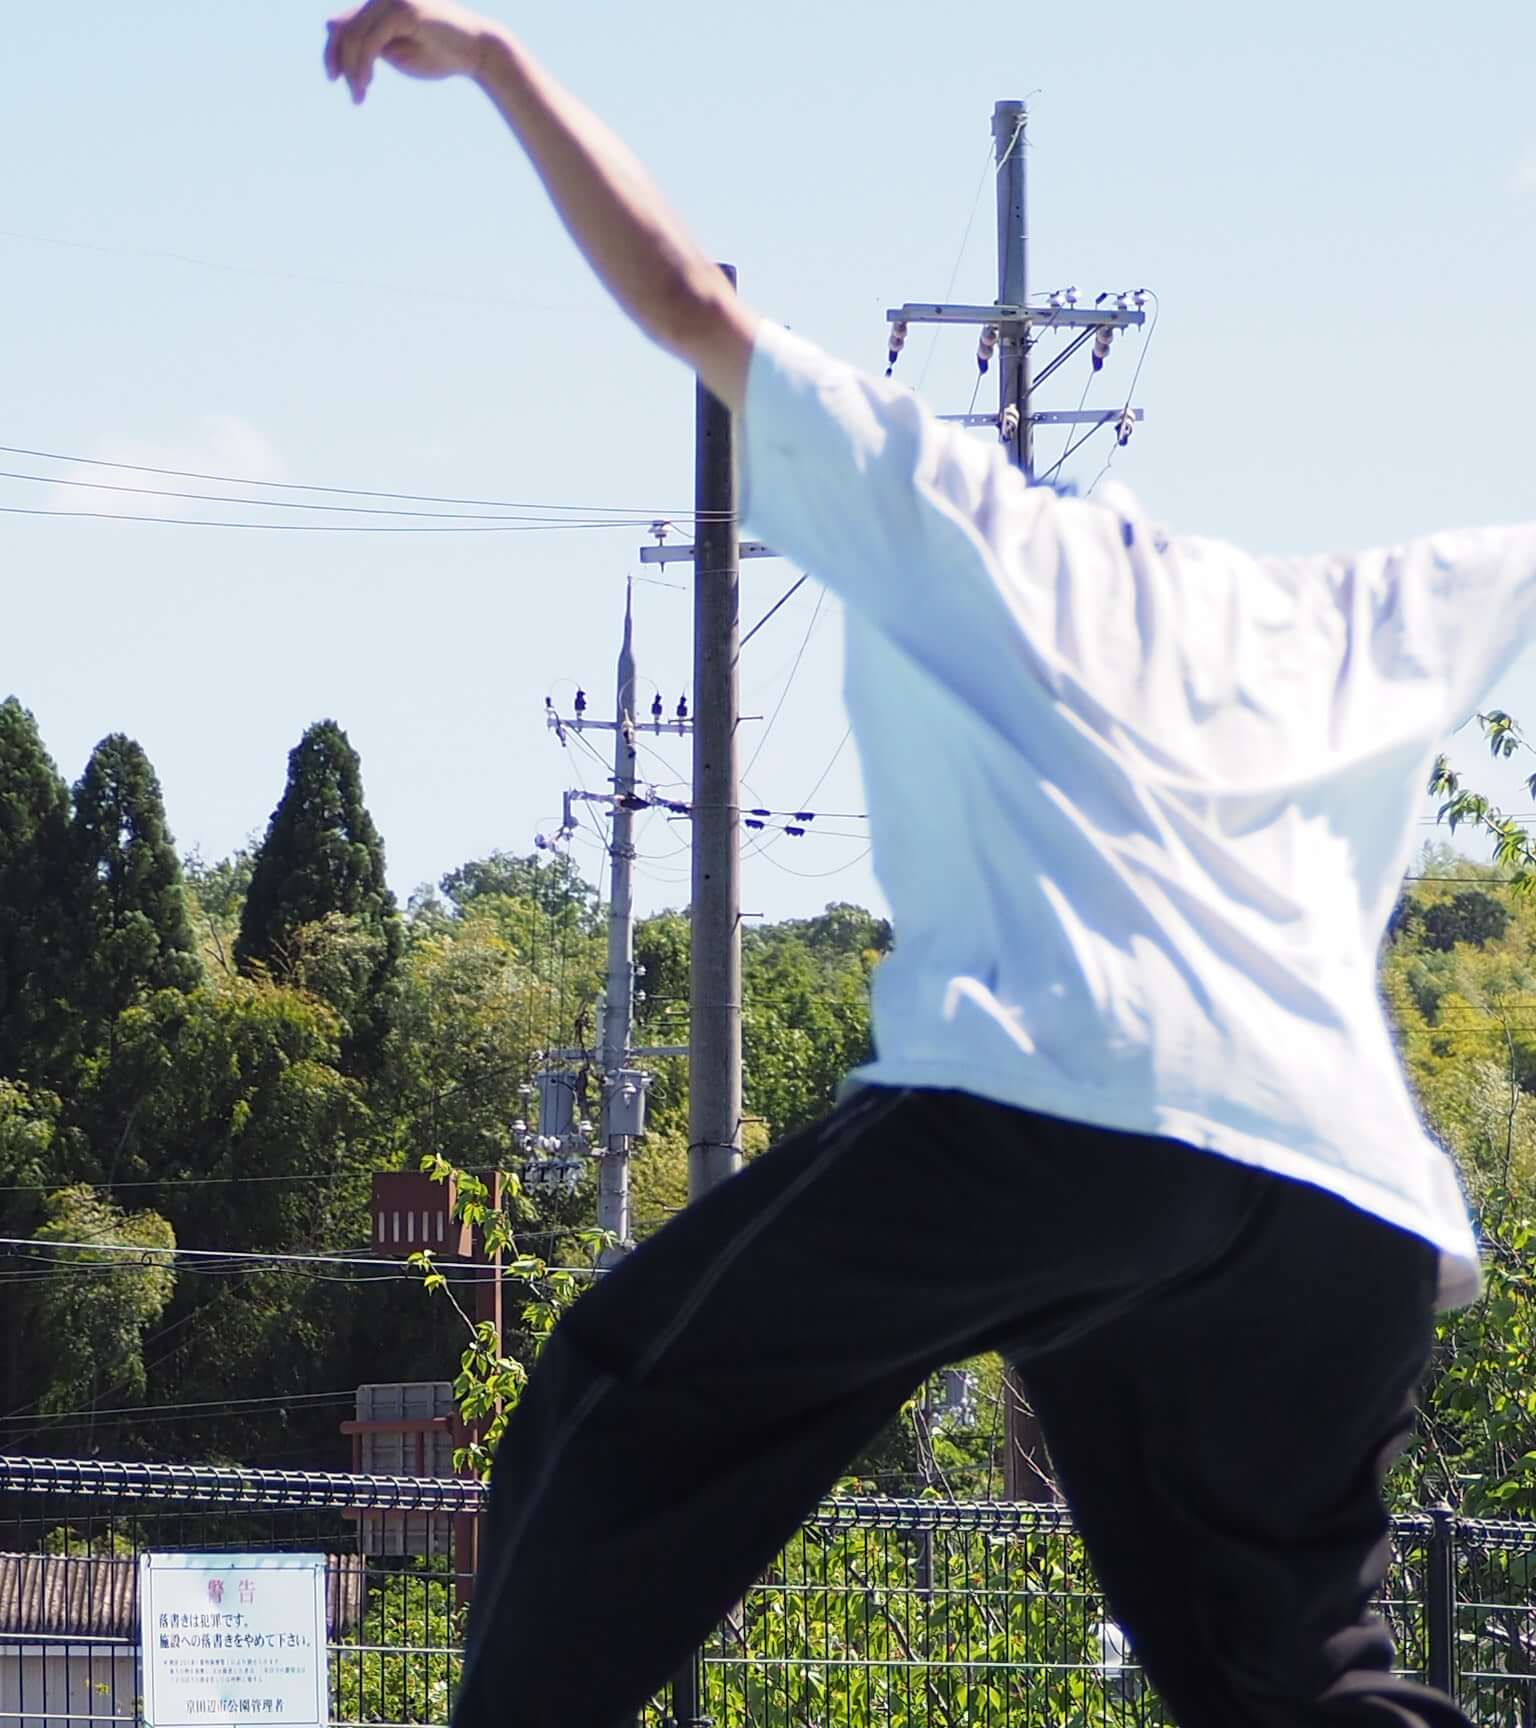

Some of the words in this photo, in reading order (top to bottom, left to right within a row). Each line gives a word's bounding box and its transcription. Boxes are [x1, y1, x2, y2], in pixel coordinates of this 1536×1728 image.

[159, 1612, 249, 1629] 落書きは犯罪です。
[159, 1633, 312, 1650] 施設への落書きをやめて下さい。
[186, 1699, 286, 1714] 京田辺市公園管理者
